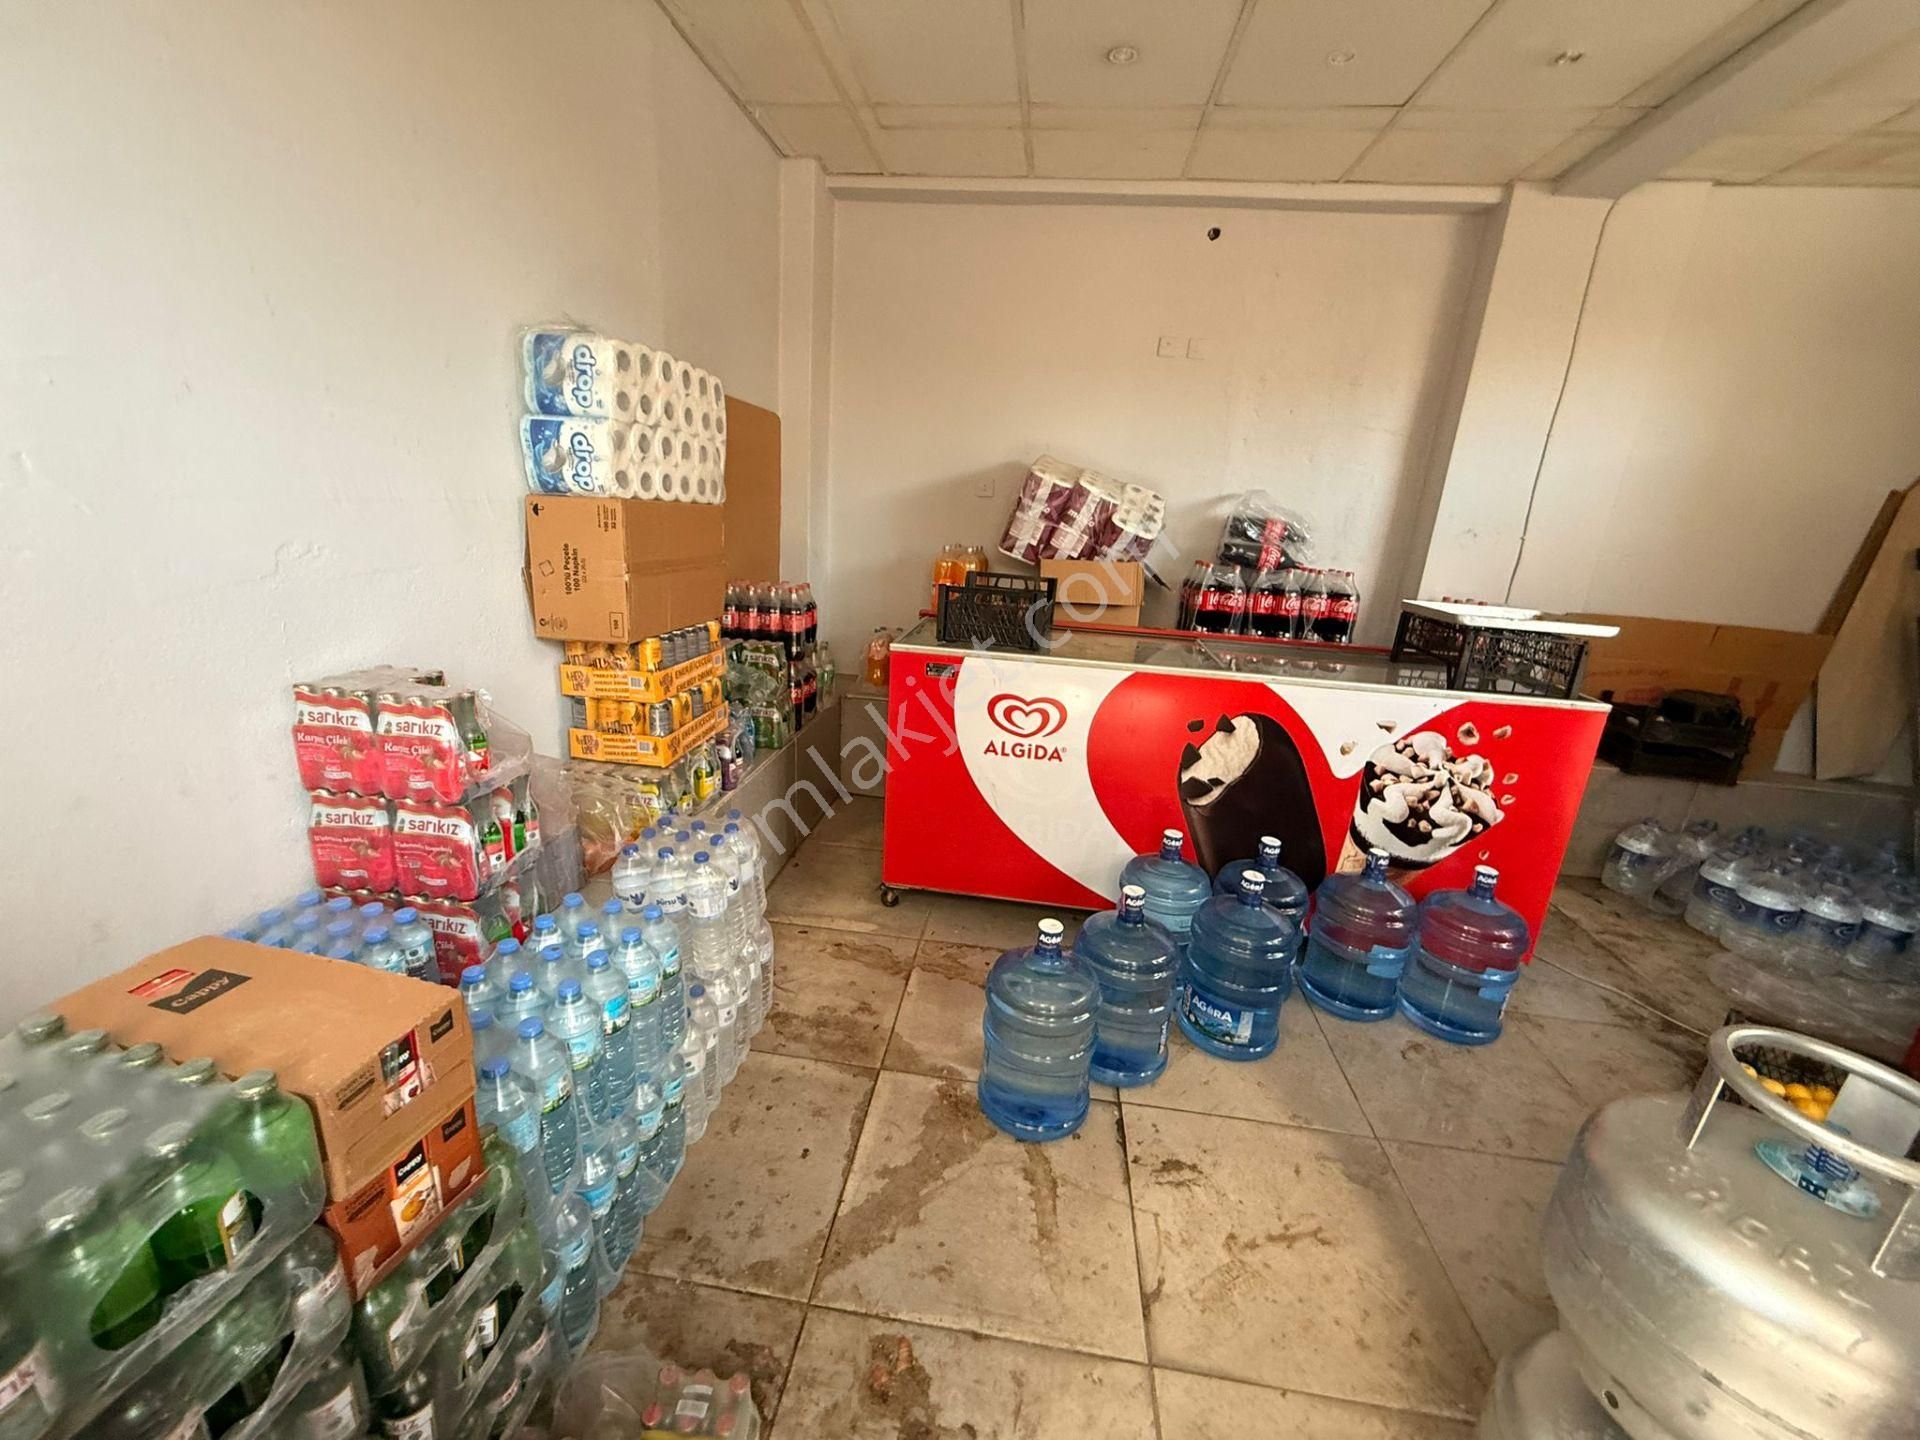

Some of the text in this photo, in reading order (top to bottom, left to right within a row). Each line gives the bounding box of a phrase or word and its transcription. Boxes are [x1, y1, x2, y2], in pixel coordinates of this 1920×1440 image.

[571, 344, 597, 408] drop
[570, 432, 594, 491] drop
[563, 543, 571, 571] Peçete
[571, 548, 579, 576] Napkin
[422, 918, 467, 934] arıkız
[171, 976, 230, 1008] Cappy
